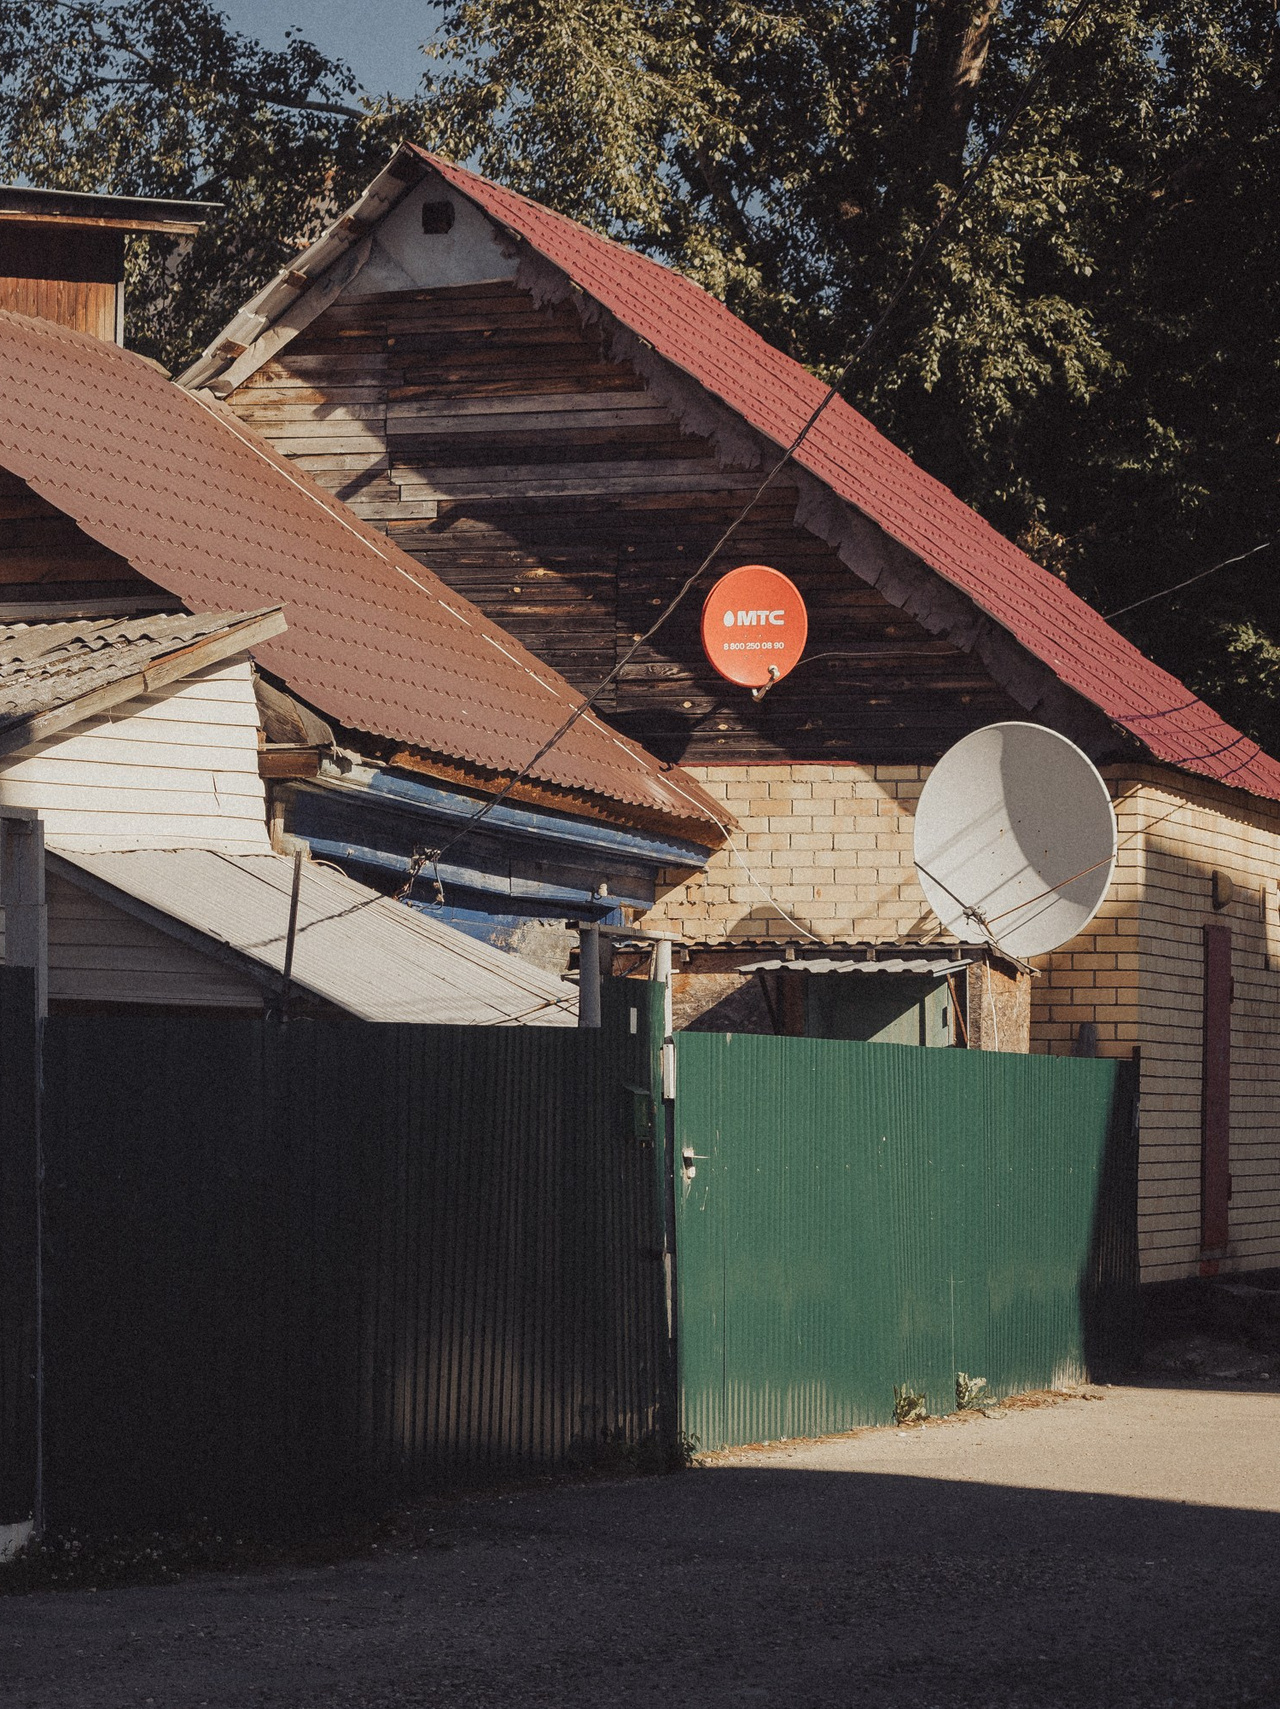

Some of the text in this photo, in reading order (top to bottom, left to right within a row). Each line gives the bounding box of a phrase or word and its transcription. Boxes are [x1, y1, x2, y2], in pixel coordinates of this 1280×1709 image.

[737, 610, 785, 626] МТС
[730, 642, 745, 650] 800
[746, 642, 760, 650] 250
